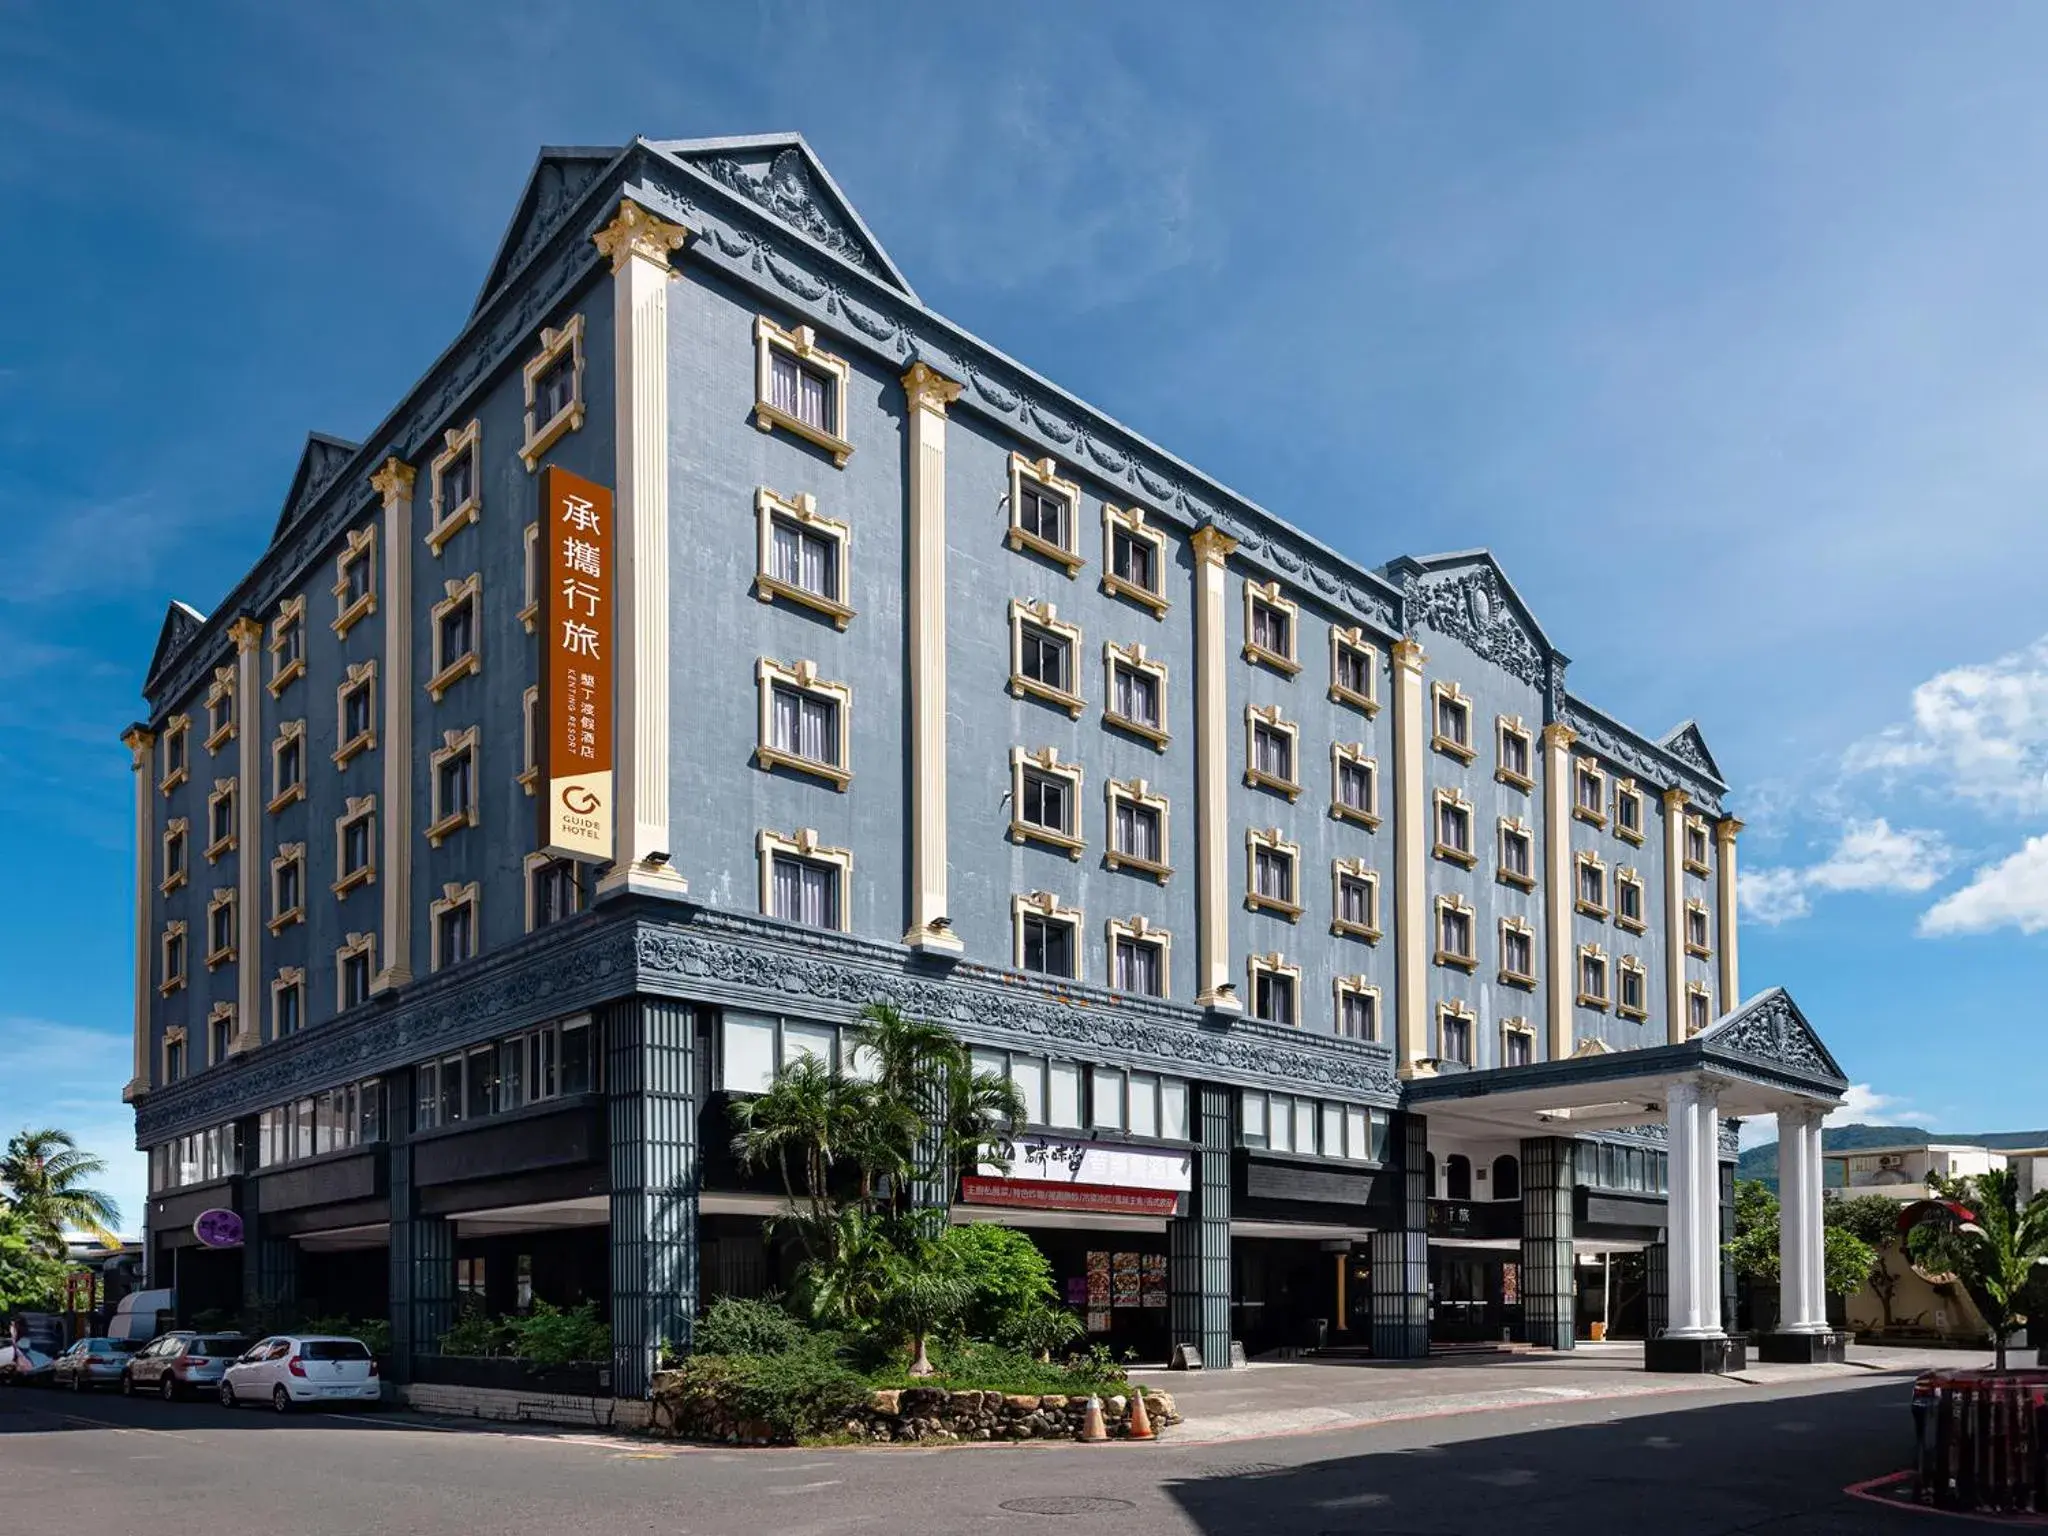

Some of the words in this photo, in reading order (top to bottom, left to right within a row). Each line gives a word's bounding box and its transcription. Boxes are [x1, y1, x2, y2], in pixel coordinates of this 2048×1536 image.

[562, 494, 601, 660] 承攜行旅
[567, 668, 577, 711] KENTING
[567, 715, 577, 755] RESORT
[562, 824, 600, 840] HOTEL
[563, 815, 600, 830] GUIDE
